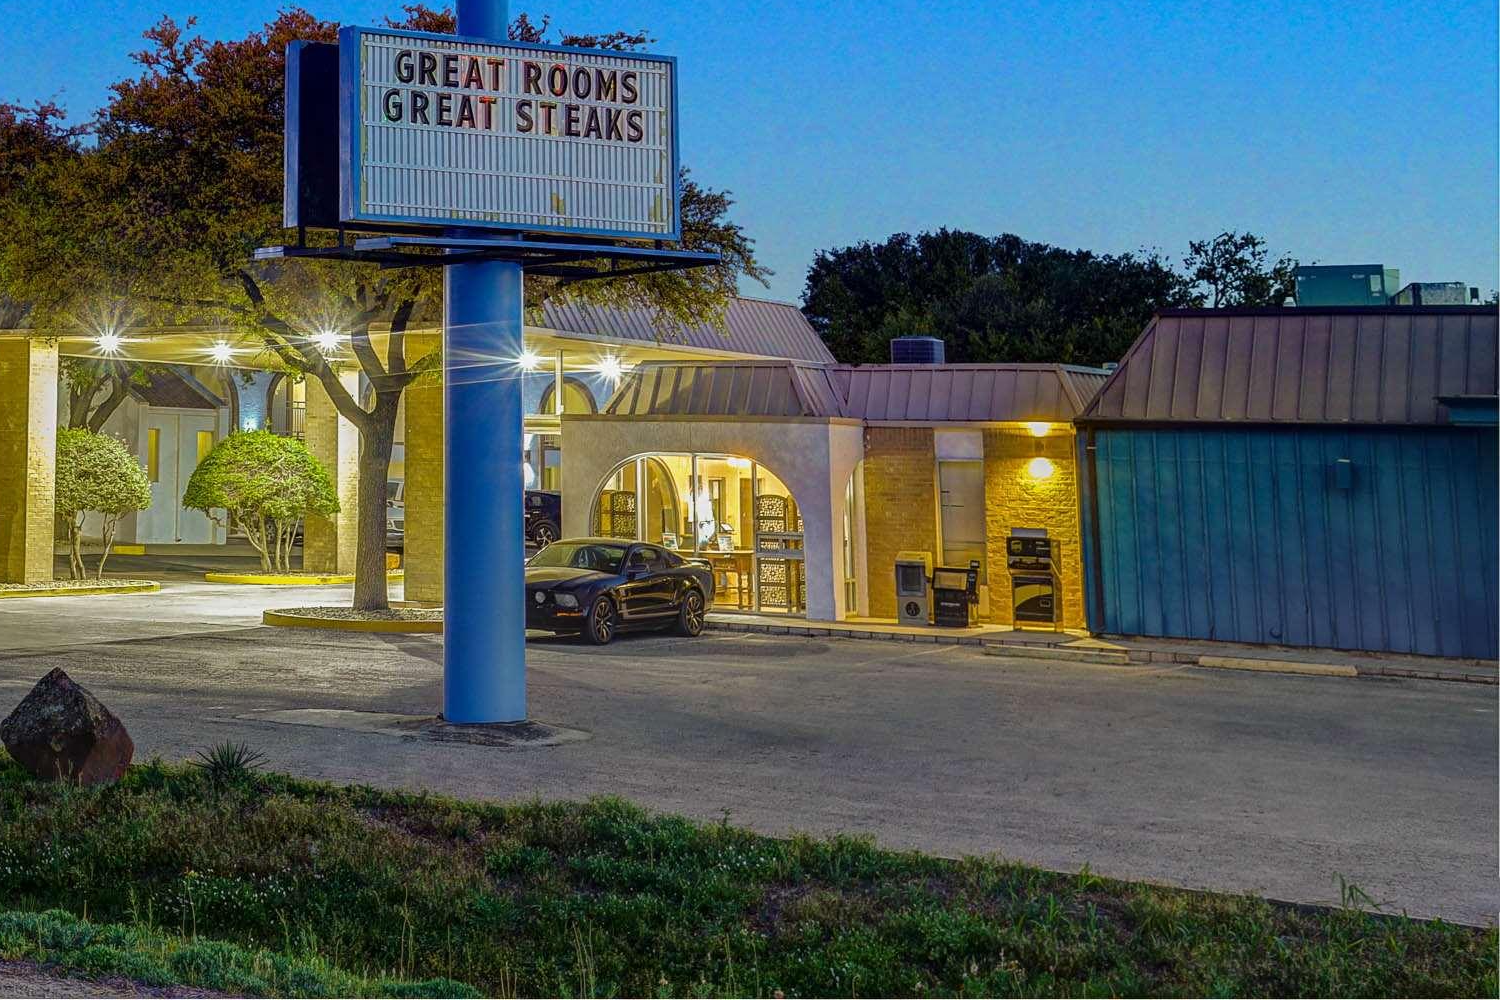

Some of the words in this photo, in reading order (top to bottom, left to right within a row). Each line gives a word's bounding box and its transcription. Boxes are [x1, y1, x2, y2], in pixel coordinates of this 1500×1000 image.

[395, 49, 505, 92] GREAT
[523, 60, 639, 104] ROOMS
[382, 88, 497, 131] GREAT
[515, 99, 645, 143] STEAKS
